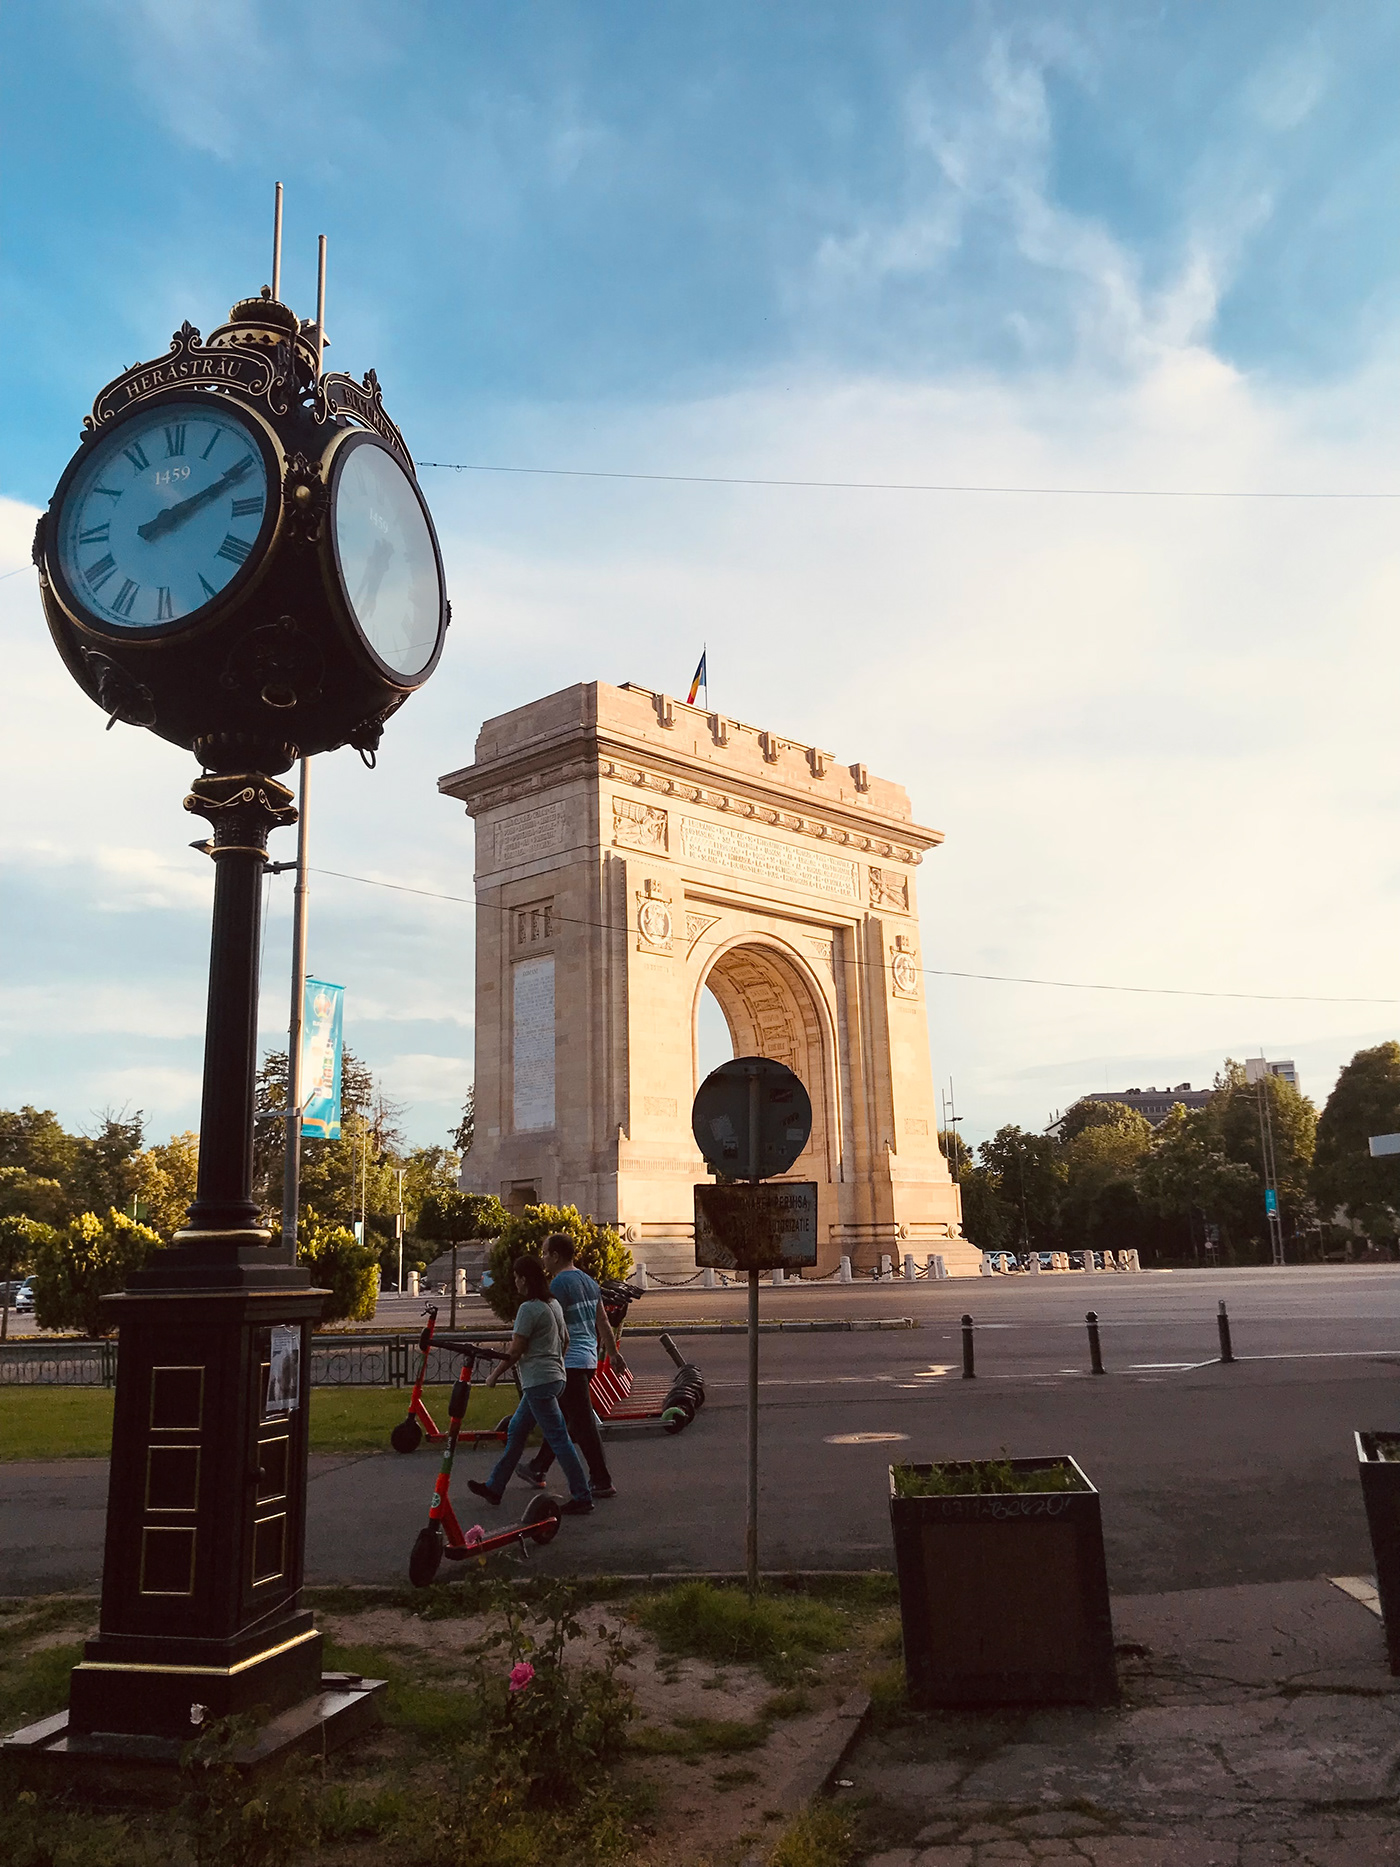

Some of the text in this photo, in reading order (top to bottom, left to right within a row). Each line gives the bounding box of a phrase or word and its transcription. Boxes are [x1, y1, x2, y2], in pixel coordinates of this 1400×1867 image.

[125, 358, 242, 398] HERĂSTRĂU
[154, 466, 190, 485] 1459
[369, 507, 388, 533] 1459
